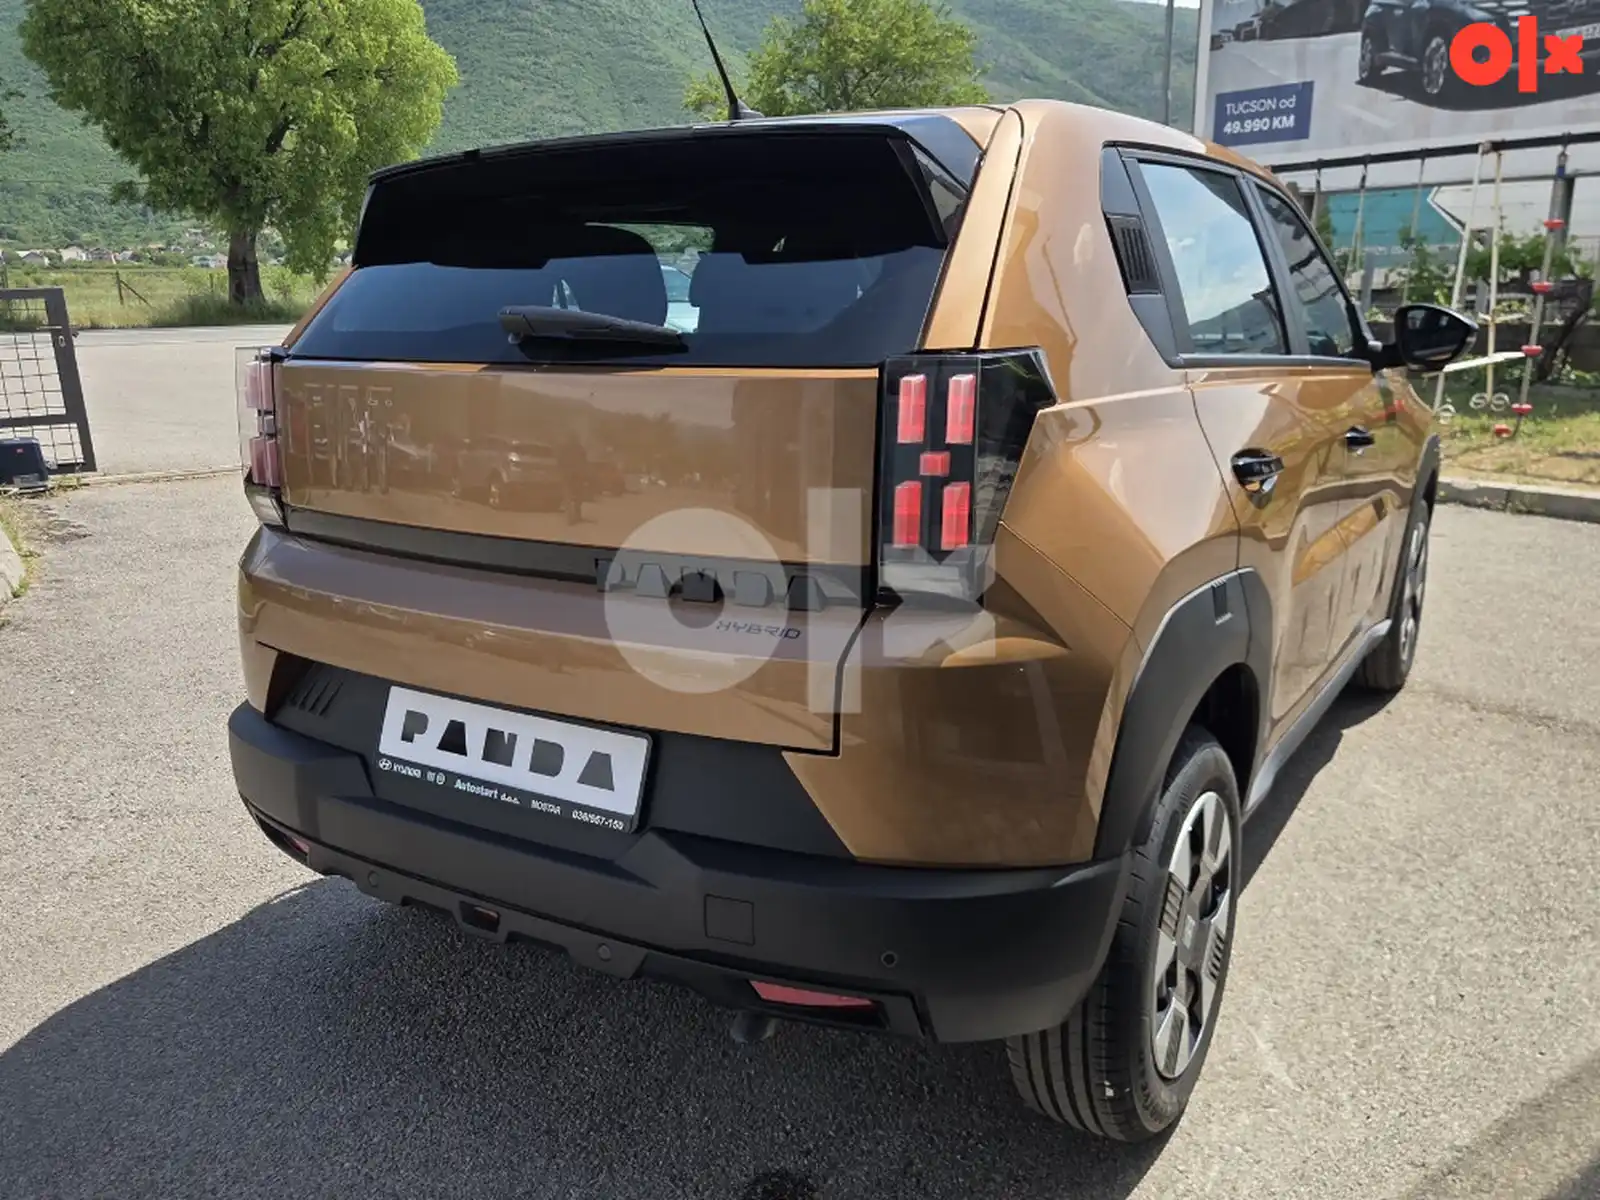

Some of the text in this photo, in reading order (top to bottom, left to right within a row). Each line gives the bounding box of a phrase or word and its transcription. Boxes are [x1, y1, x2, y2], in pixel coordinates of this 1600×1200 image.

[1225, 94, 1296, 116] TUCSON od
[1223, 113, 1296, 135] 49.990 KM
[594, 556, 831, 612] PANDA
[716, 620, 801, 640] HYBRID
[400, 709, 615, 792] PANDA
[454, 779, 499, 800] Autostart
[531, 799, 561, 816] MOSTAR
